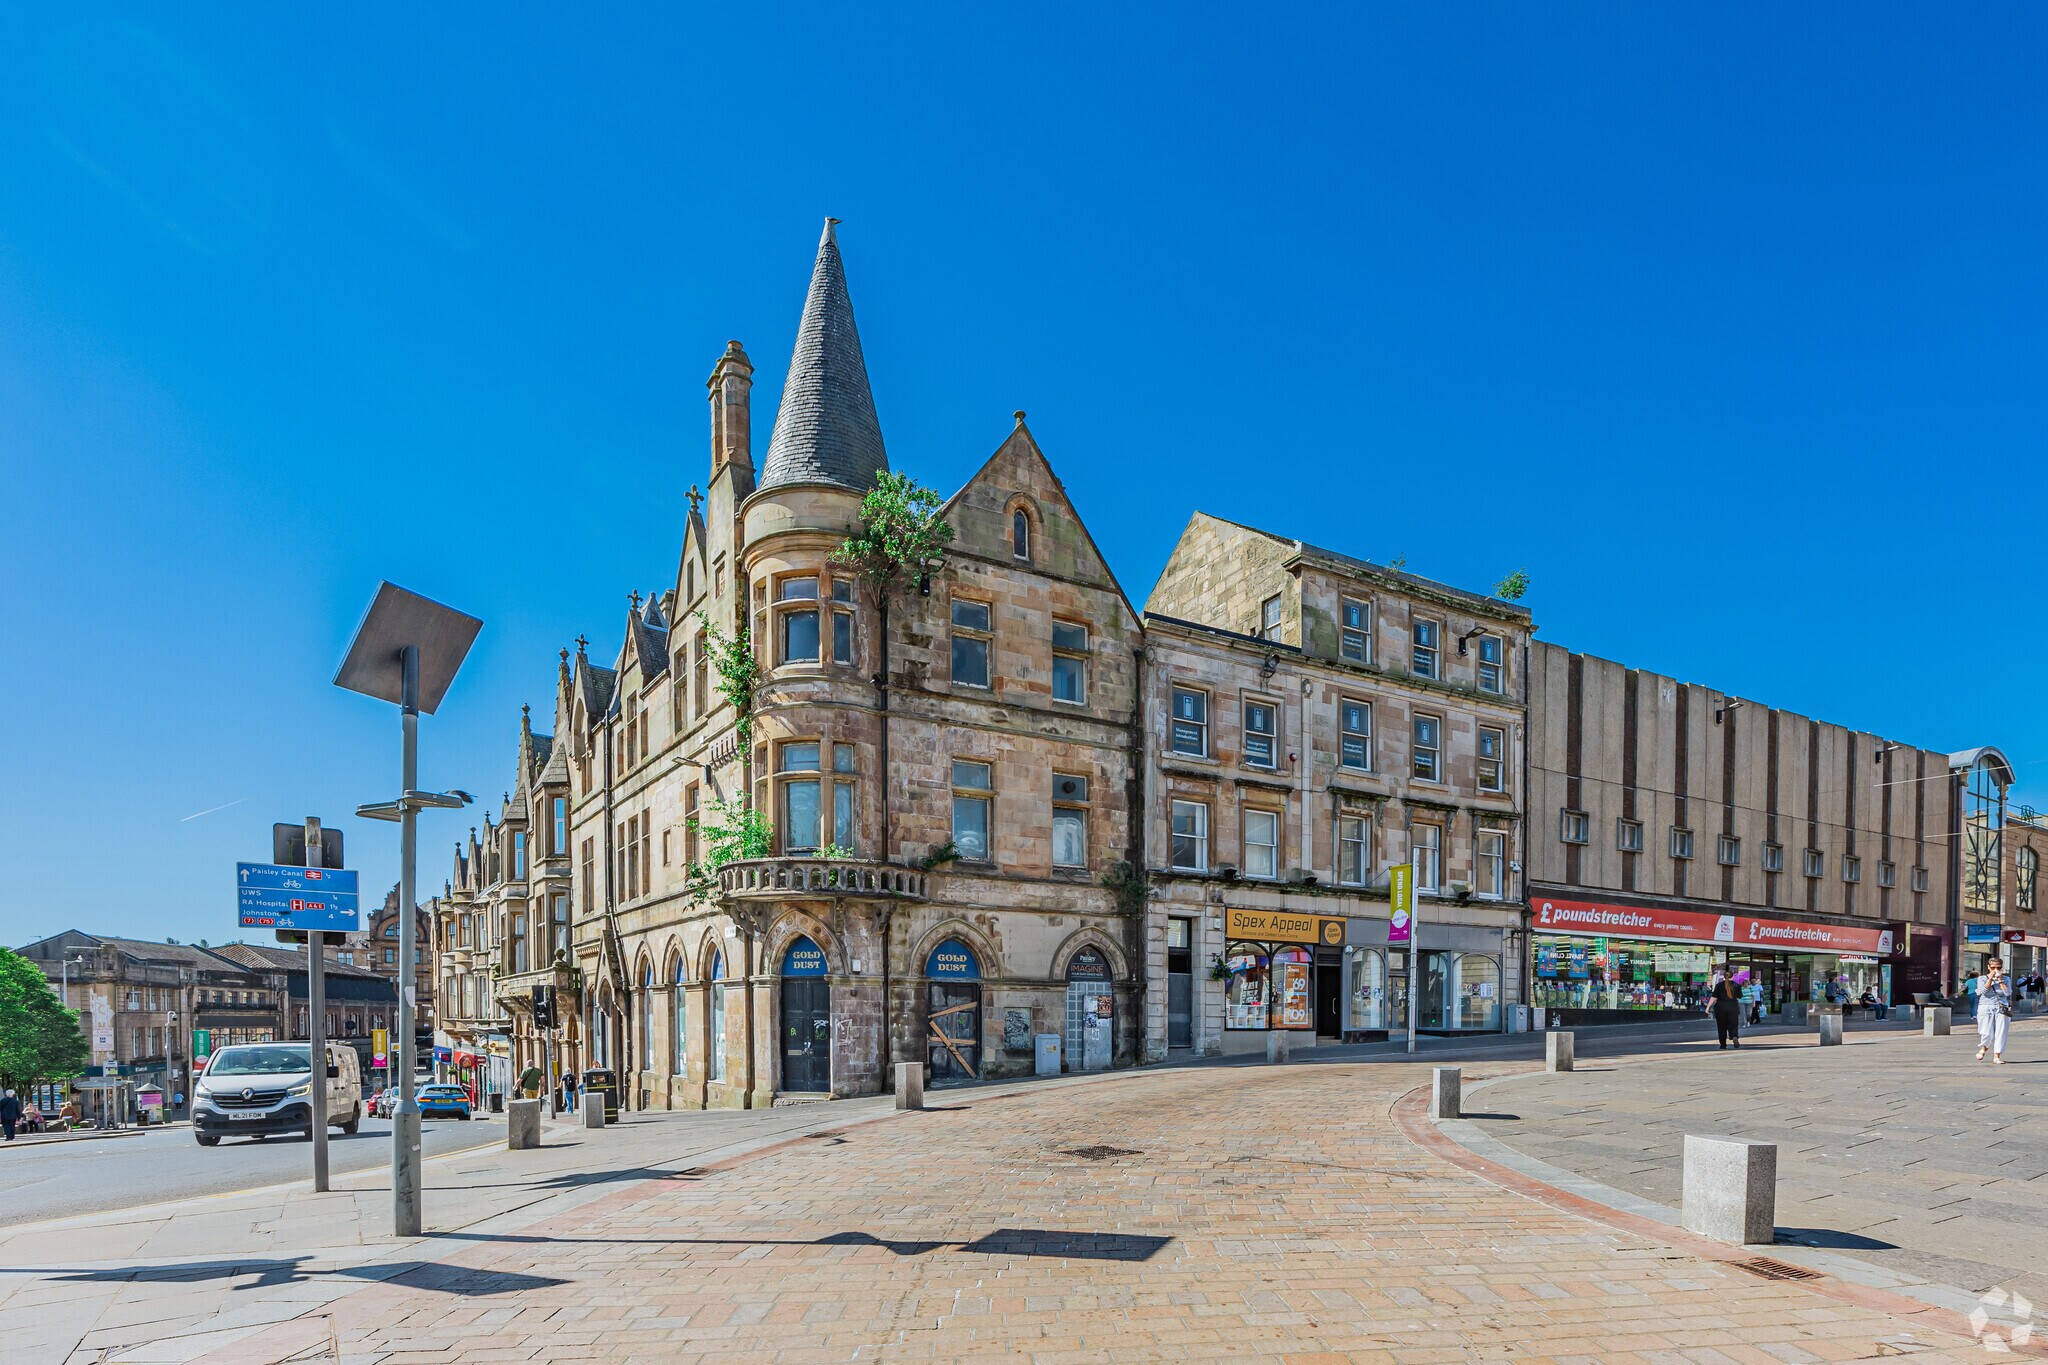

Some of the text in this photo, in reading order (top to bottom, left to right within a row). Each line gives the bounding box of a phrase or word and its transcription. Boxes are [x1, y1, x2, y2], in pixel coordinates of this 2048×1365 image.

[252, 868, 279, 876] Paisley
[281, 869, 303, 877] Canal
[256, 900, 289, 908] Hospital
[293, 900, 303, 909] H
[1553, 907, 1652, 928] poundstretcher
[1233, 913, 1313, 933] Spex Appeal
[1758, 925, 1832, 942] poundstretcher
[1896, 942, 1905, 955] 9
[792, 951, 821, 959] GOLD
[937, 953, 967, 962] GOLD
[793, 961, 821, 969] DUST
[938, 963, 967, 971] DUST
